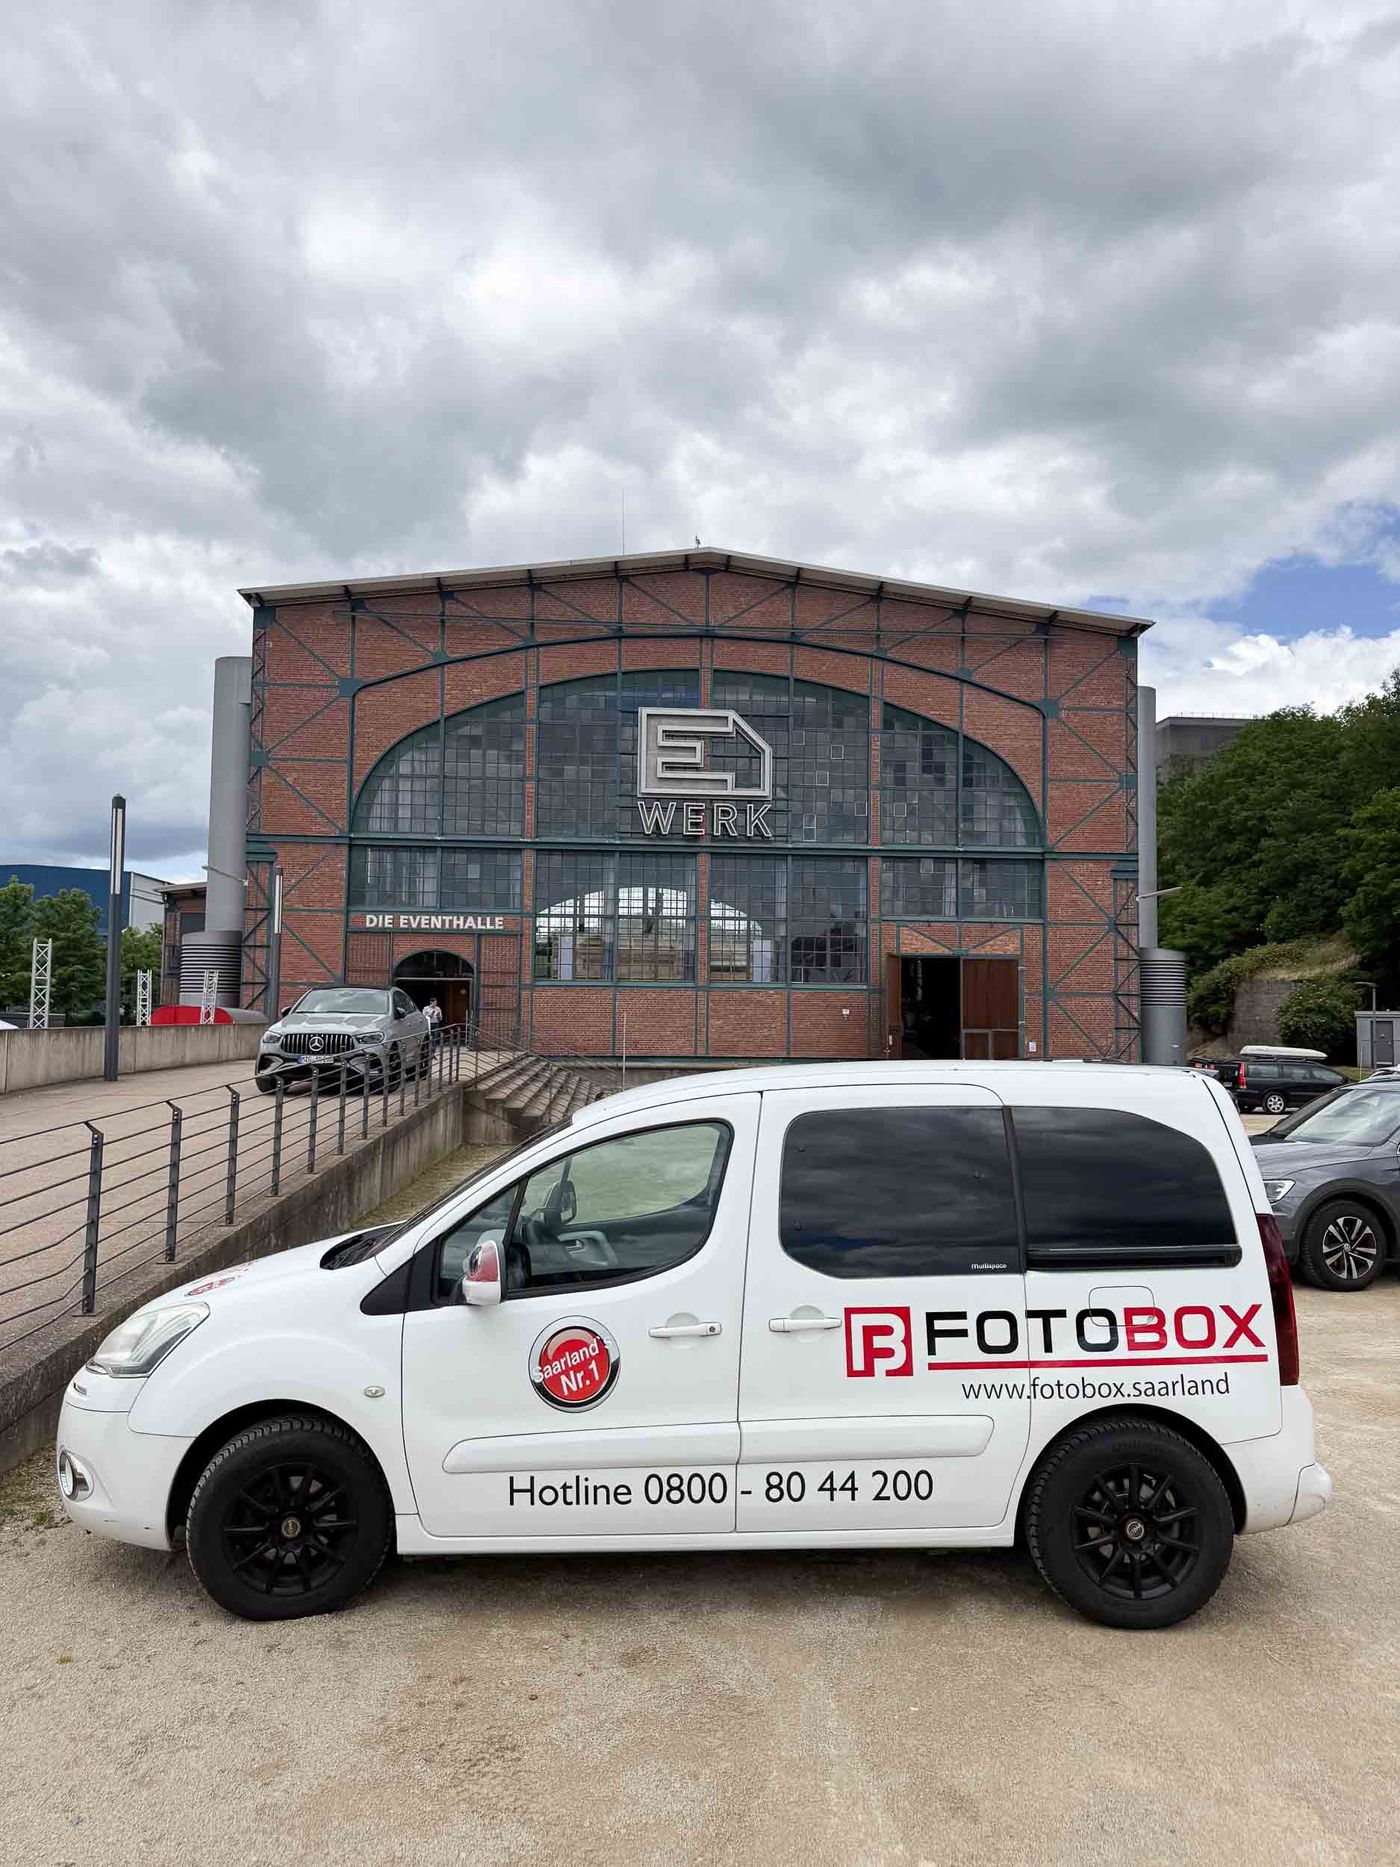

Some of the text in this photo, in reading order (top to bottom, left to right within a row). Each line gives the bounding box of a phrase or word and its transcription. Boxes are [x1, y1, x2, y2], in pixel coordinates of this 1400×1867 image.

[637, 801, 773, 837] WERK
[365, 914, 504, 930] DIE EVENTHALLE
[925, 1303, 1266, 1356] FOTOBOX
[961, 1372, 1230, 1401] www.fotobox.saarland
[509, 1475, 632, 1506] Hotline
[644, 1472, 728, 1505] 0800
[765, 1471, 806, 1503] 80
[817, 1470, 859, 1502] 44
[872, 1469, 934, 1501] 200
